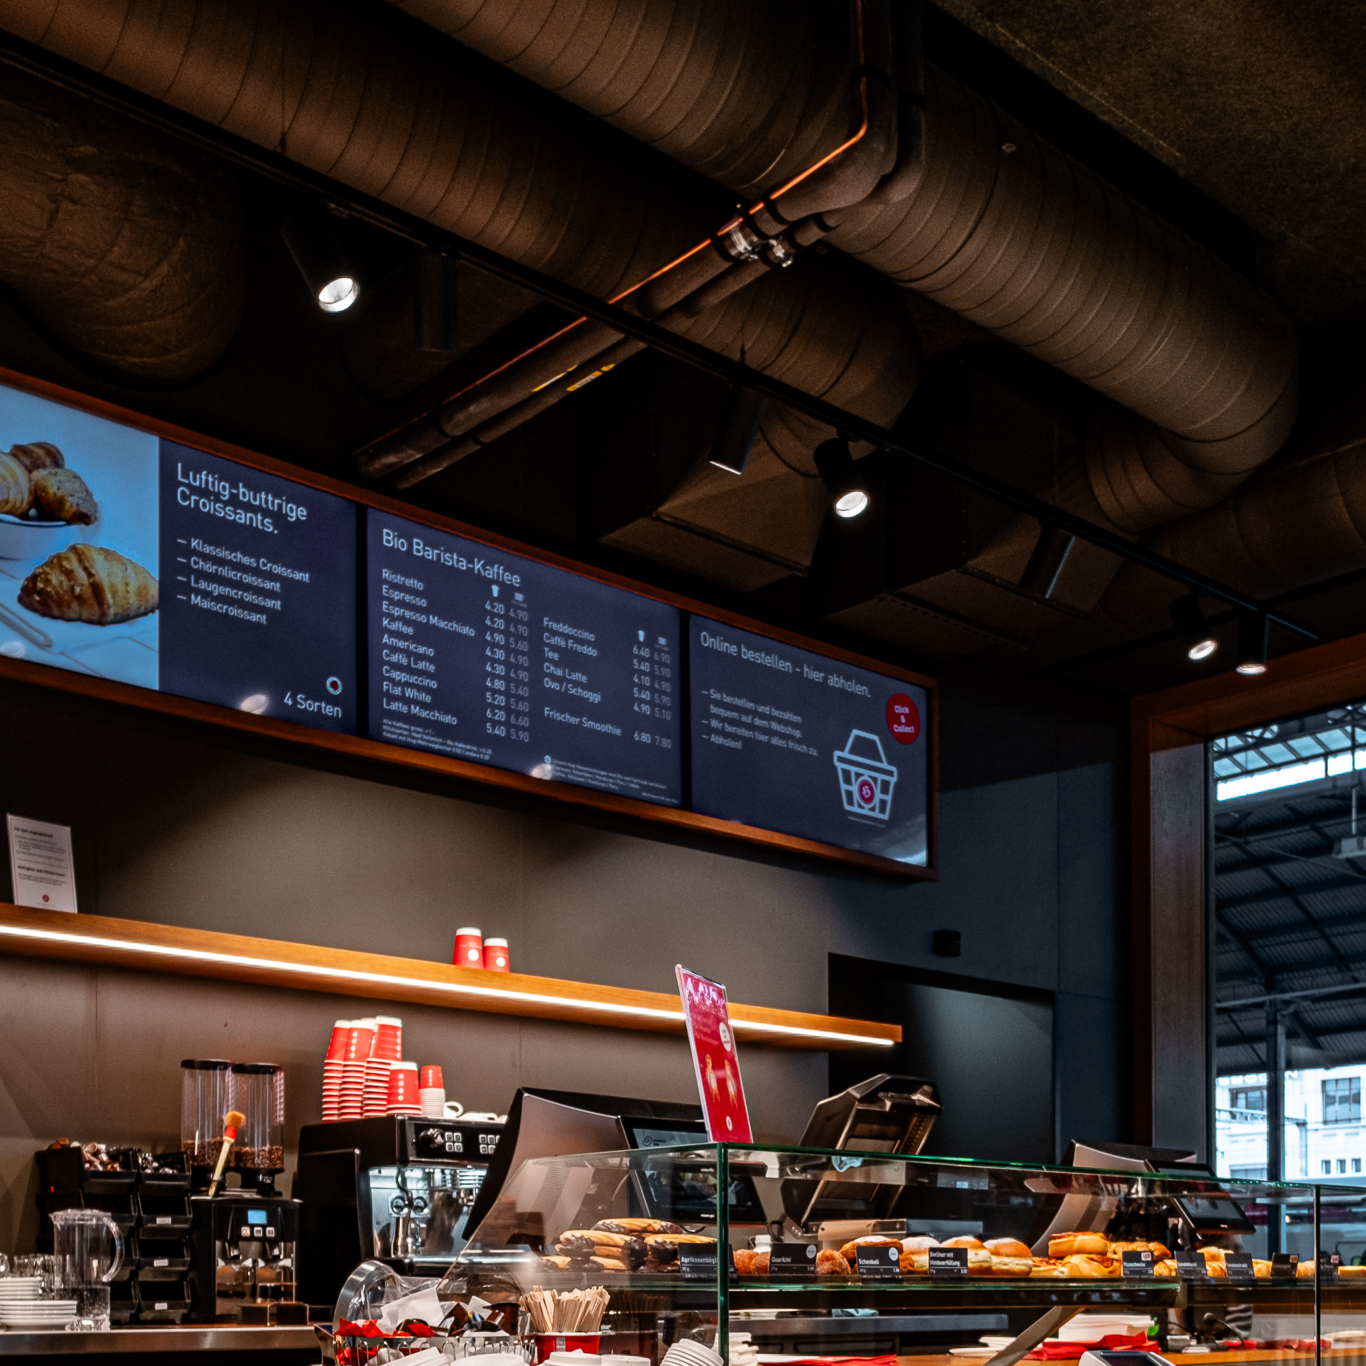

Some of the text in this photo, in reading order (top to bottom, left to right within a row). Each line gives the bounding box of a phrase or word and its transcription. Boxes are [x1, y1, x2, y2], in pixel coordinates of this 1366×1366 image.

[177, 462, 308, 522] Luftig-buttrige
[177, 487, 278, 534] Croissants.
[190, 537, 310, 583] Klassisches Croissant
[190, 557, 281, 593] Chörnlicroissant
[382, 528, 521, 587] Bio Barista-Kaffee
[190, 575, 281, 611] Laugencroissant
[190, 594, 267, 625] Maiscroissant
[382, 568, 528, 622] Ristretto 4.20 4.90
[382, 585, 528, 637] Espresso 4.20 4.90
[382, 601, 427, 624] Espresso
[429, 613, 475, 637] Macchiato
[485, 631, 505, 646] 4.90
[543, 617, 595, 642] Freddoccino
[382, 617, 528, 667] Kaffee 4.30 4.90
[382, 634, 434, 657] Americano
[485, 661, 505, 676] 4.30
[543, 632, 566, 649] Caffè
[567, 639, 598, 657] Freddo
[543, 647, 559, 661] Tee
[382, 648, 408, 666] Caffè
[410, 656, 435, 673] Latte
[485, 677, 505, 692] 4.80
[543, 662, 563, 677] Chai
[565, 668, 587, 684] Latte
[700, 631, 738, 656] Online
[741, 644, 792, 673] bestellen
[803, 663, 824, 683] hier
[827, 673, 871, 698] abholen.
[382, 665, 437, 689] Cappuccino
[486, 691, 506, 706] 5.20
[383, 681, 402, 697] Flat
[404, 687, 432, 703] White
[486, 707, 506, 722] 6.20
[544, 677, 559, 692] Ovo
[567, 684, 601, 704] Schoggi
[283, 691, 342, 719] 4 Sorten
[383, 697, 408, 714] Latte
[411, 704, 457, 726] Macchiato
[486, 722, 506, 738] 5.40
[544, 707, 580, 727] Frischer
[582, 716, 621, 737] Smoothie
[709, 688, 802, 723] Sie bestellen und bezahlen
[710, 704, 739, 722] bequem
[741, 713, 752, 724] auf
[753, 716, 769, 729] dem
[894, 704, 910, 715] Click
[710, 718, 723, 731] Wir
[725, 723, 753, 740] bereiten
[755, 731, 768, 743] hier
[770, 734, 787, 748] alles
[788, 739, 807, 754] frisch
[710, 733, 742, 750] Abholen!
[893, 723, 915, 734] Collect
